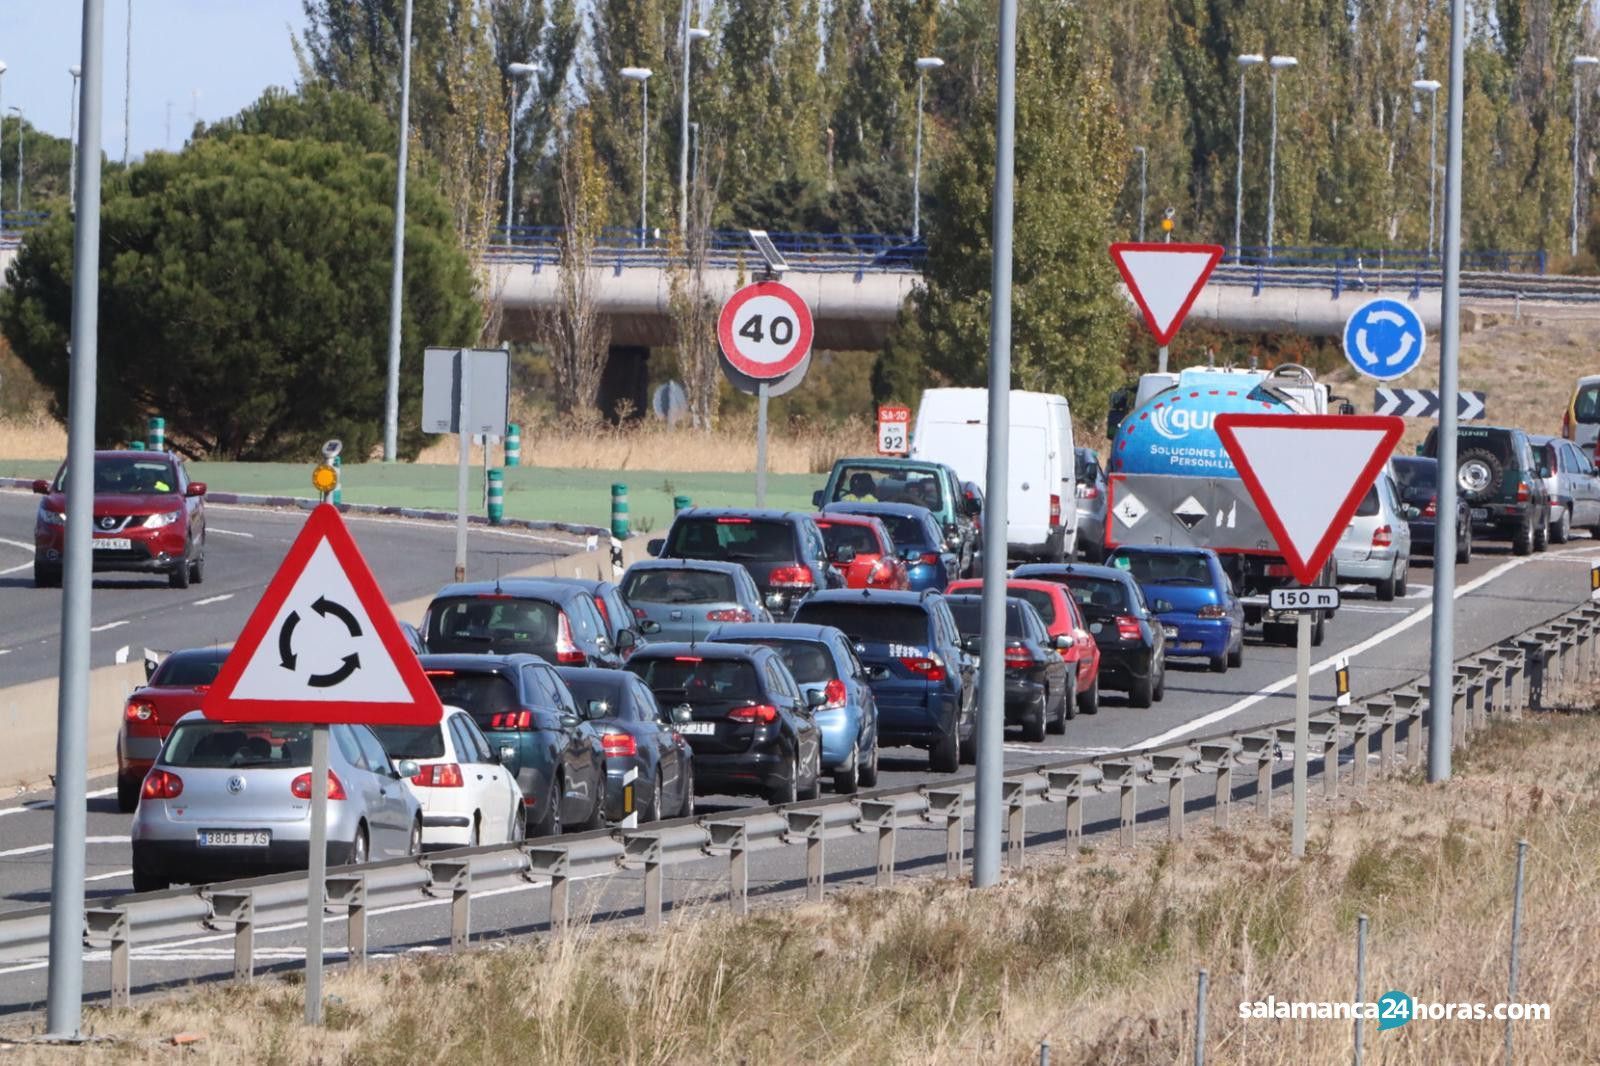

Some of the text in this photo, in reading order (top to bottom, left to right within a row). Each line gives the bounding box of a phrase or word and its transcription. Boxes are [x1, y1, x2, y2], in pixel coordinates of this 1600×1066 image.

[738, 314, 793, 346] 40
[884, 436, 903, 449] 92
[1150, 444, 1217, 458] SOLUCIONES
[1170, 456, 1236, 469] PERSONALIZ
[1279, 591, 1331, 606] 150 m
